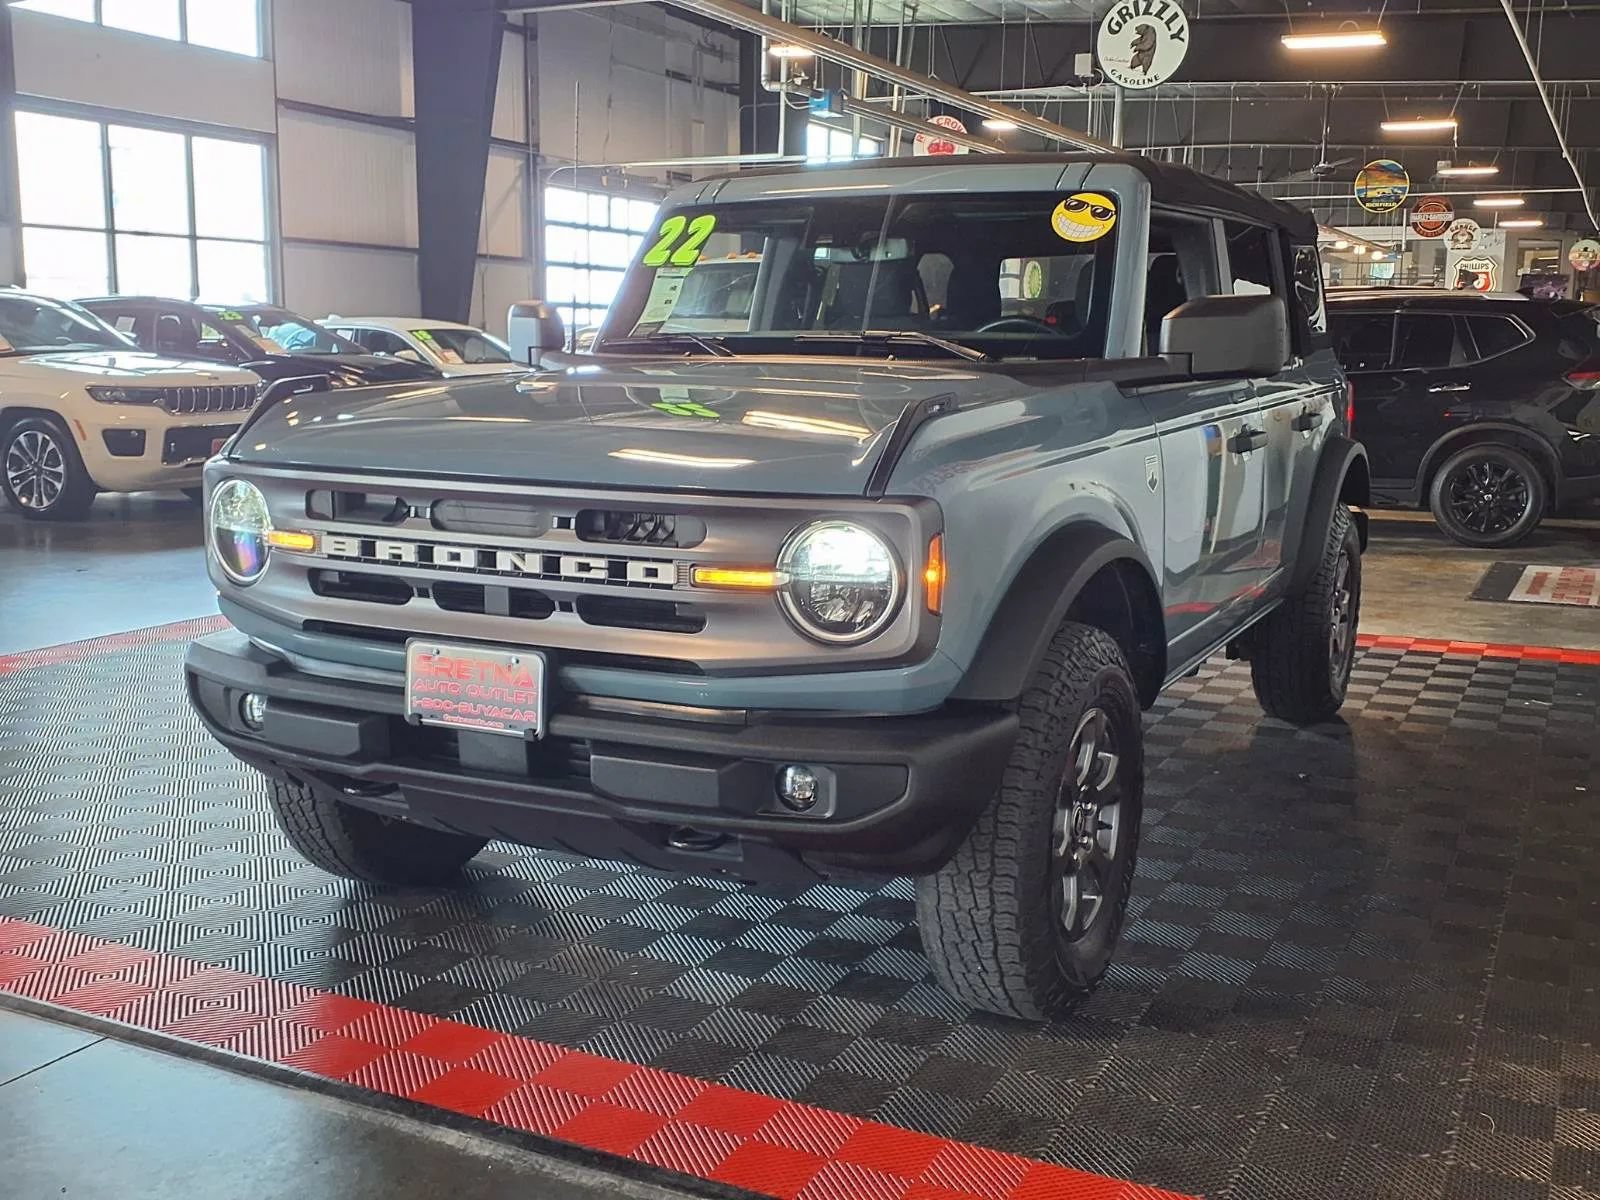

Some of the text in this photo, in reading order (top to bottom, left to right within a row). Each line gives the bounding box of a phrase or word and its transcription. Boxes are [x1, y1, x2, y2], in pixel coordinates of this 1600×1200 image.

[1107, 0, 1185, 43] GRIZZLY
[1110, 68, 1161, 86] GASOLINE
[643, 214, 717, 266] 22
[1460, 262, 1490, 270] PHILLIPS
[321, 535, 677, 585] BRONCO
[414, 653, 537, 688] GRETNA
[412, 678, 538, 705] AUTO OUTLET
[410, 696, 538, 723] 1-800-BUYACAR
